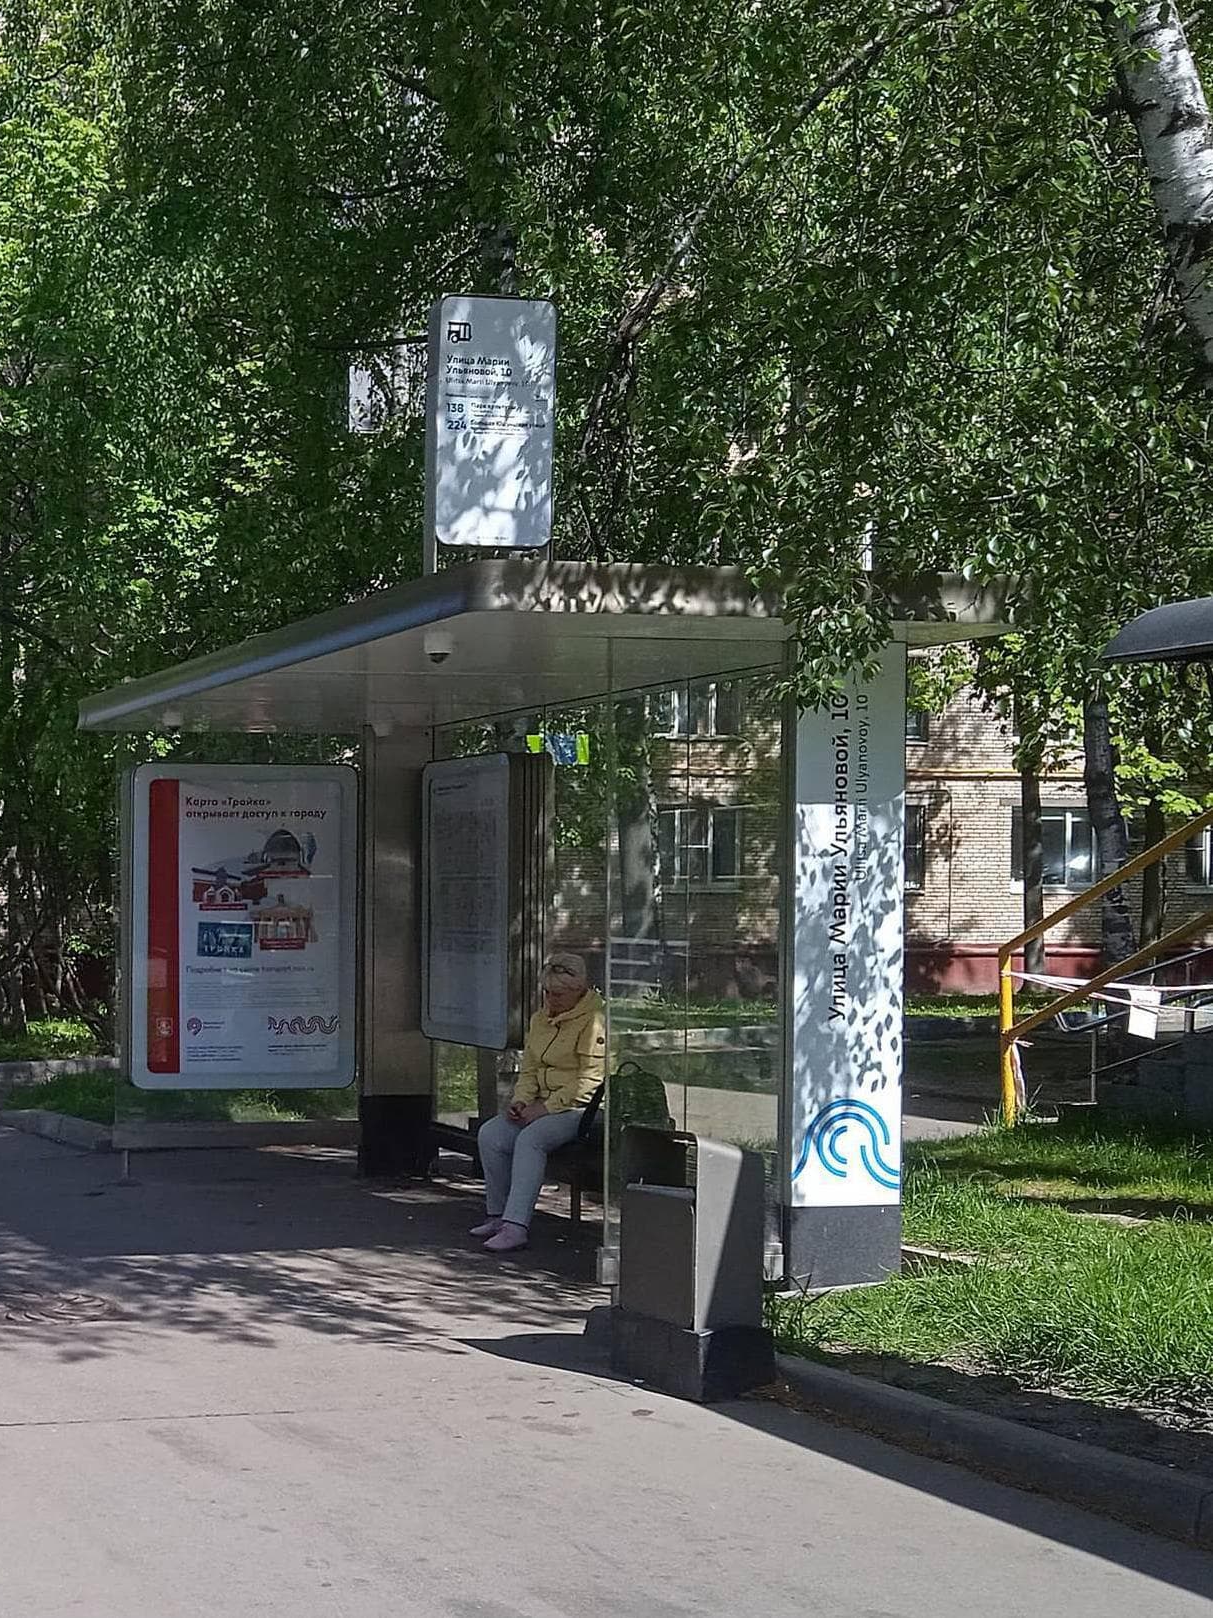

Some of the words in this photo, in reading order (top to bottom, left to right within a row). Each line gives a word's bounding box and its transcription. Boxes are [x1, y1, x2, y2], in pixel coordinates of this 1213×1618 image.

[446, 355, 475, 366] Улица
[477, 356, 510, 367] Марии
[501, 368, 513, 377] 10
[446, 402, 464, 413] 138
[447, 419, 467, 430] 224
[856, 694, 868, 710] 10
[855, 716, 871, 794] Ulyanovoy,
[829, 728, 852, 857] Ульяновой,
[242, 809, 278, 820] доступ
[290, 809, 327, 820] городу
[828, 865, 851, 945] Марии
[828, 953, 849, 1021] Улица
